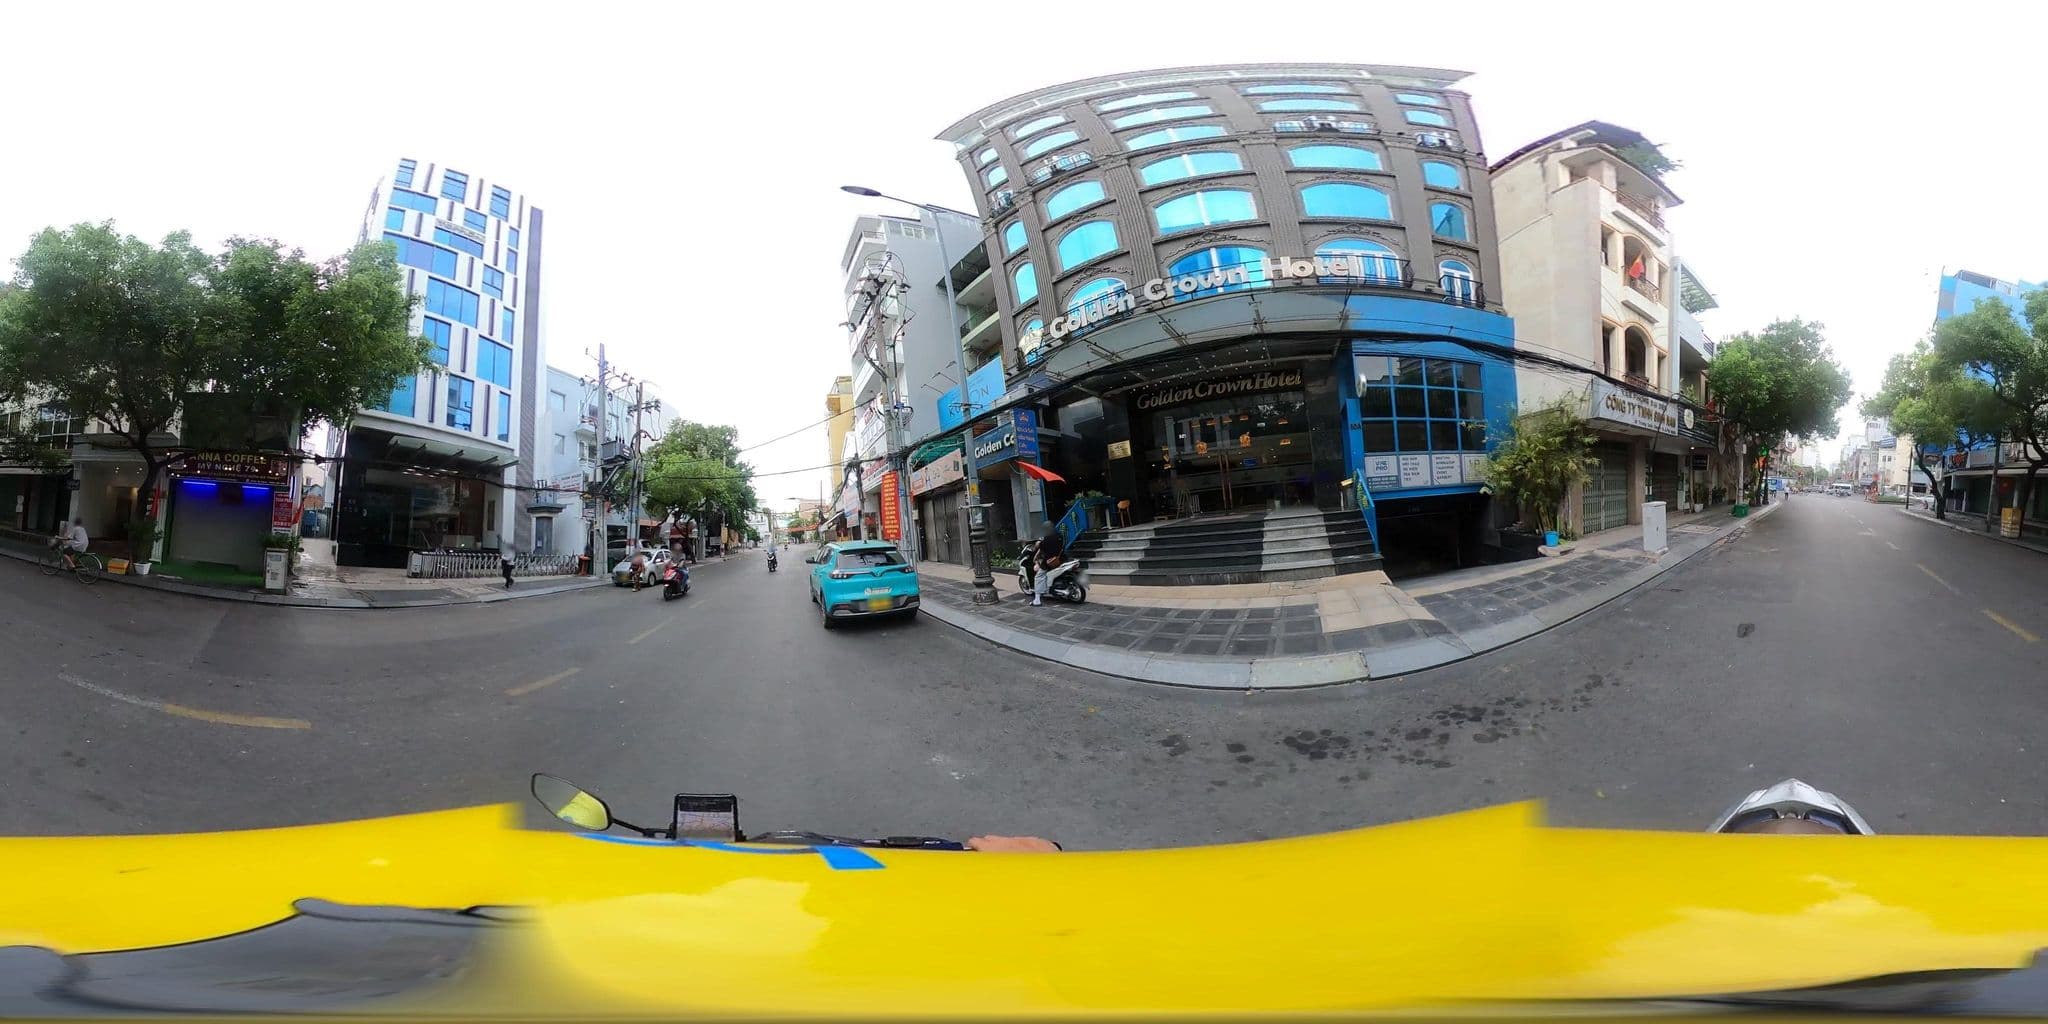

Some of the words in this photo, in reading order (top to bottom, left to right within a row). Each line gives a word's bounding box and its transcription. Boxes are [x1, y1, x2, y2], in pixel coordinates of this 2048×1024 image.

[1050, 289, 1137, 340] Golden
[1143, 263, 1250, 302] Crown
[1262, 253, 1357, 281] Hotel
[1137, 384, 1194, 411] Golden
[1195, 378, 1256, 400] Crown
[1255, 371, 1301, 391] Hotel
[224, 453, 267, 465] COFFEE
[974, 439, 1002, 459] Golden
